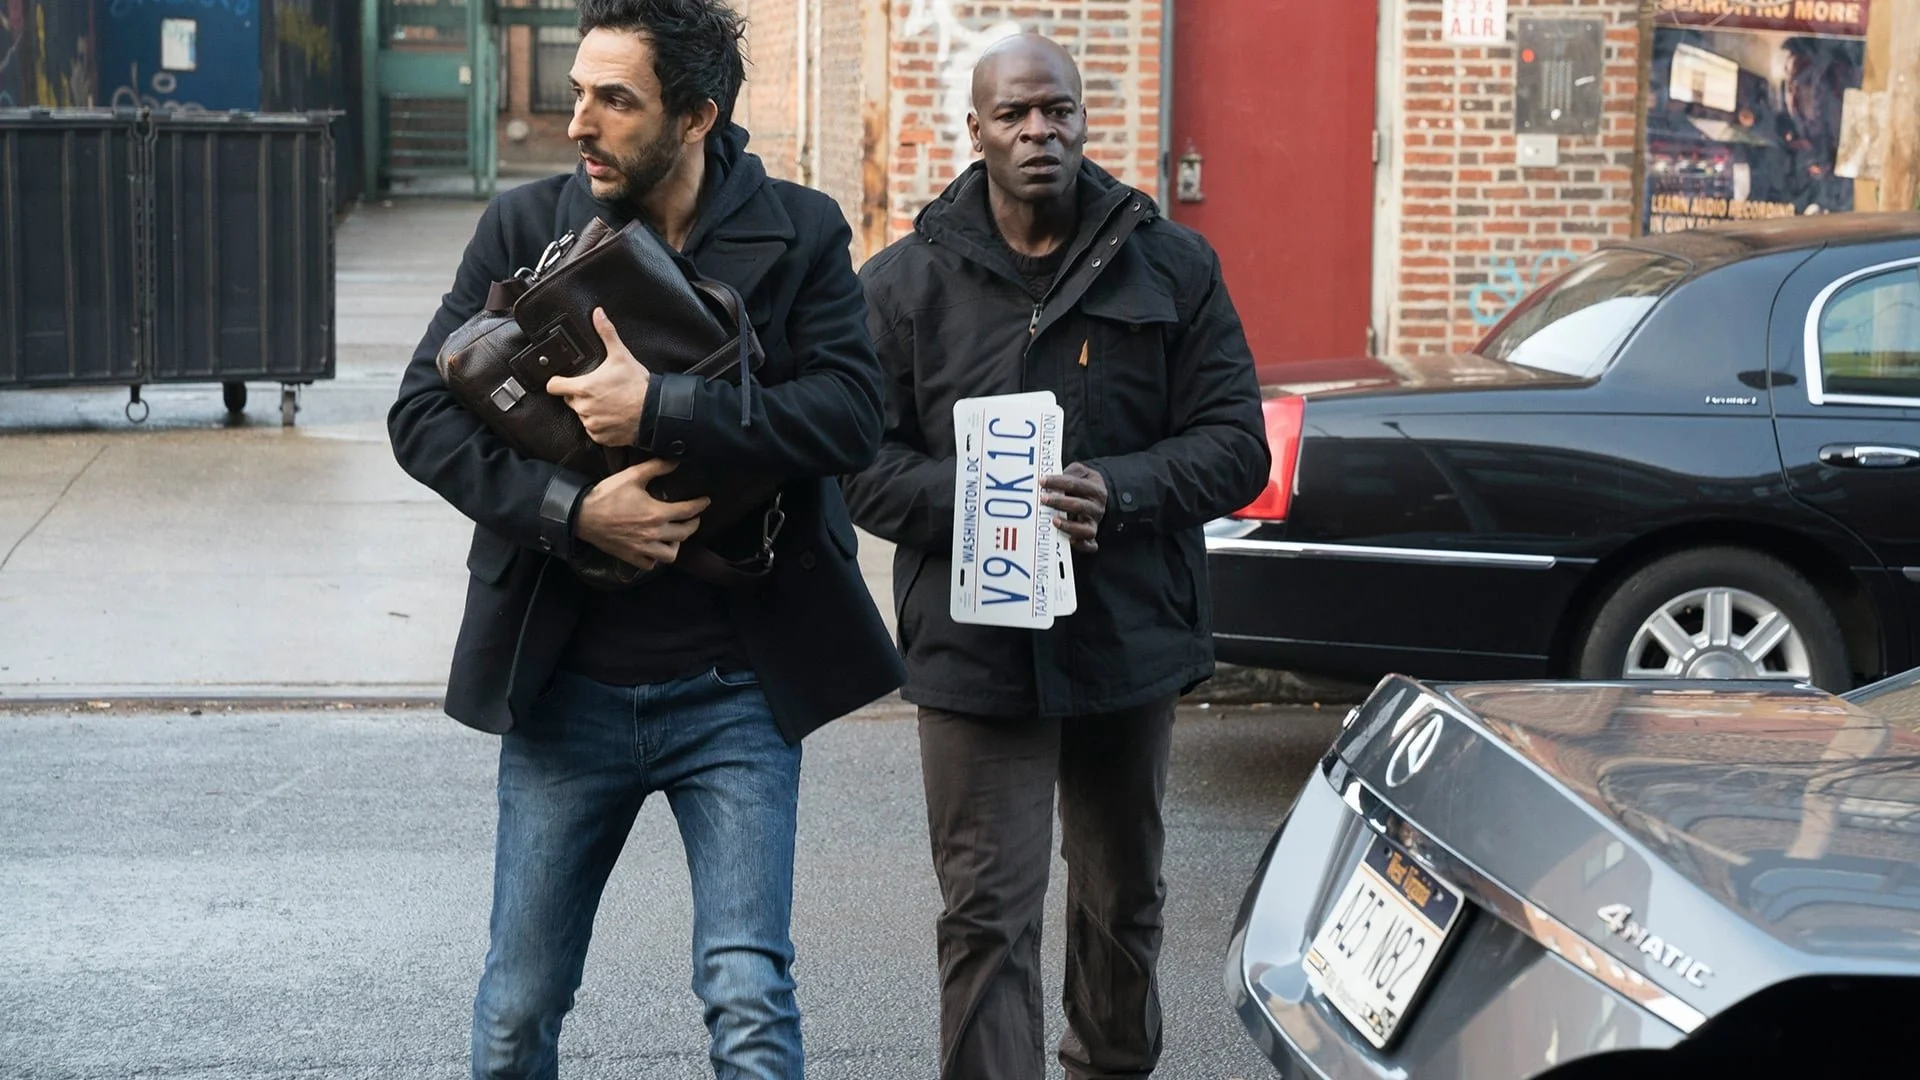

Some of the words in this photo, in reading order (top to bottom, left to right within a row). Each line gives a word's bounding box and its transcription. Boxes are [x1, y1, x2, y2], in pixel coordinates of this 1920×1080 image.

[1794, 1, 1860, 23] MORE
[1651, 194, 1689, 214] LEARN
[1690, 197, 1727, 217] AUDIO
[967, 457, 980, 472] DC
[1038, 511, 1052, 561] WITHOUT
[981, 557, 1031, 606] V9
[1035, 566, 1049, 617] TAXATION
[1361, 914, 1426, 1002] N82
[1597, 903, 1713, 988] 4MATIC
